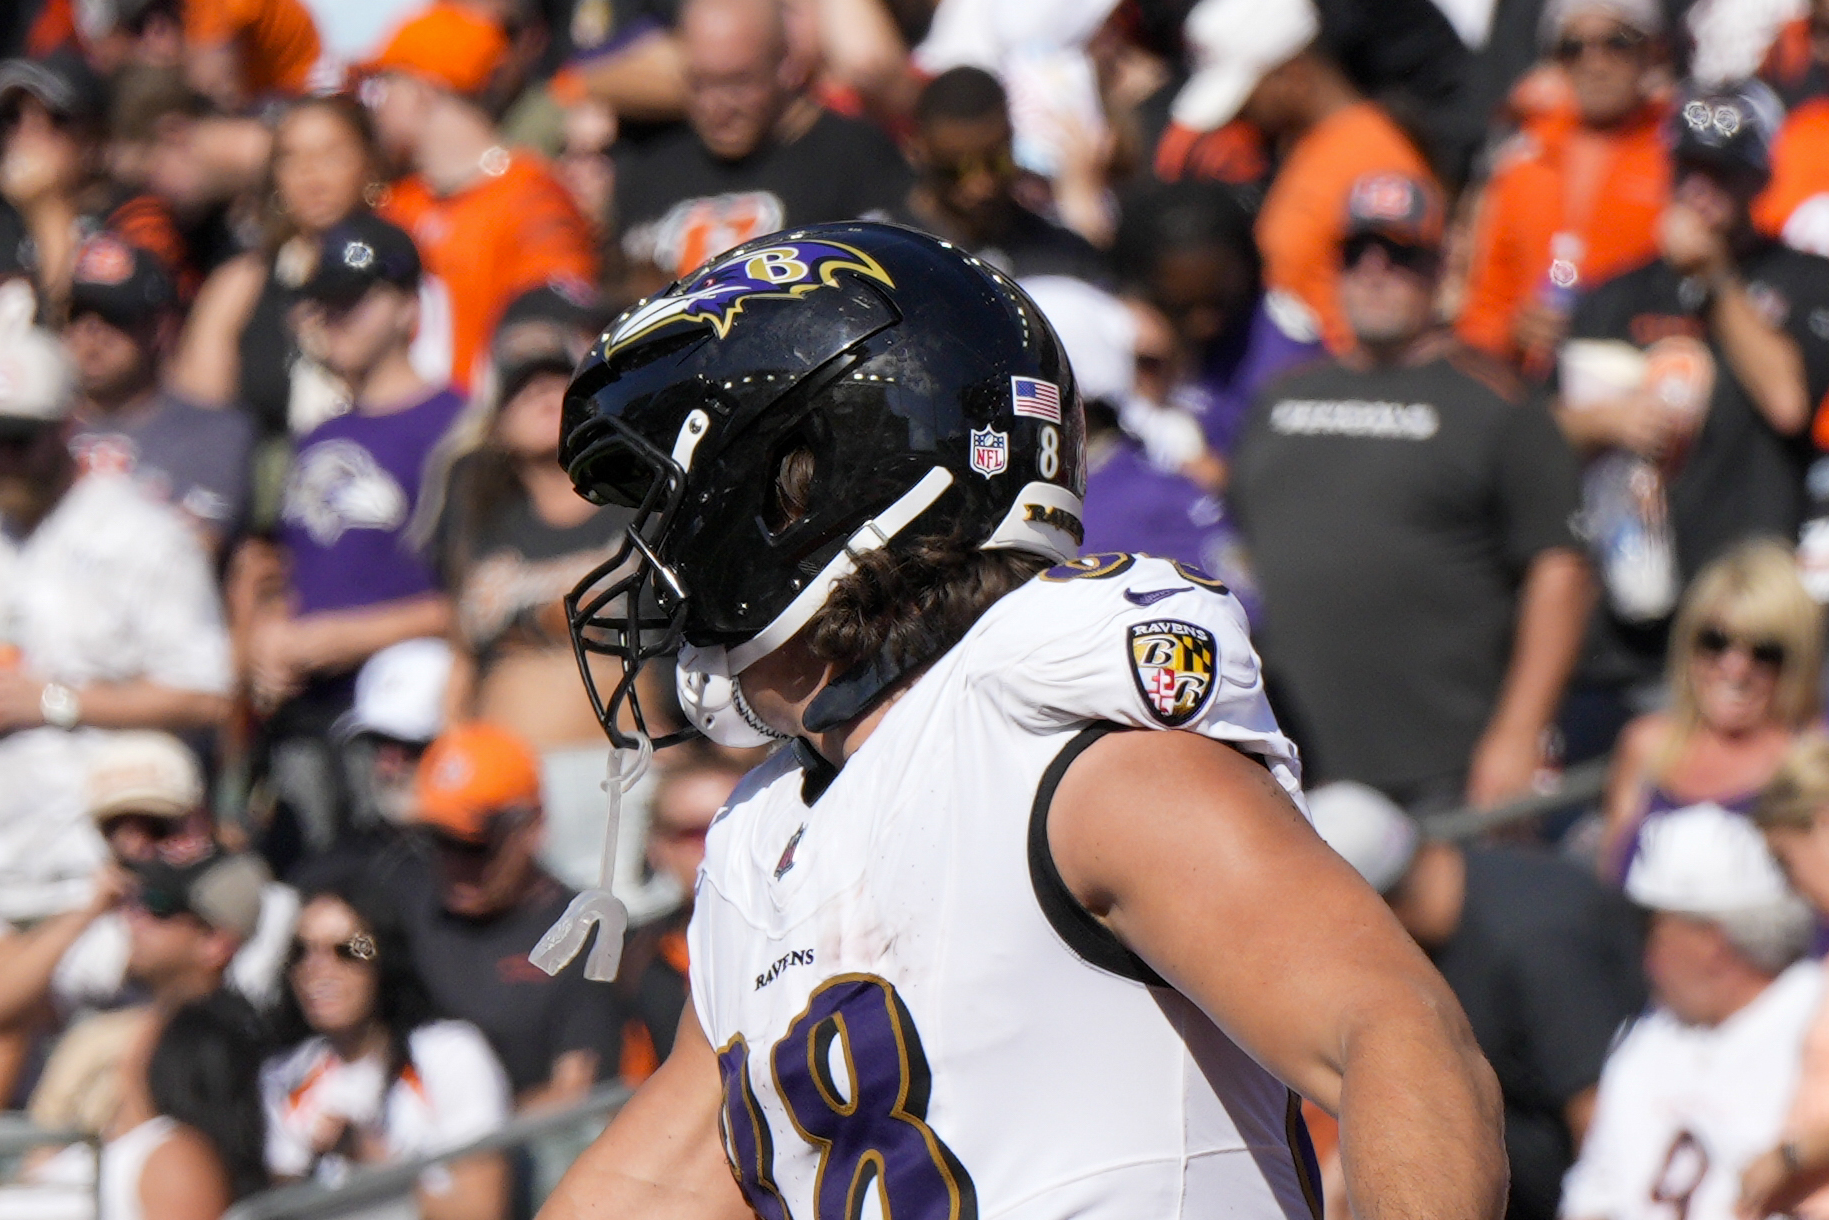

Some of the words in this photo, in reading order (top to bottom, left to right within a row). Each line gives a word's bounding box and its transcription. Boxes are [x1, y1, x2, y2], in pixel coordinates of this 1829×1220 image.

[713, 246, 809, 284] B
[975, 448, 1003, 470] NFL
[1036, 425, 1059, 479] 8
[1132, 622, 1209, 641] RAVENS
[754, 949, 815, 992] RAVENS
